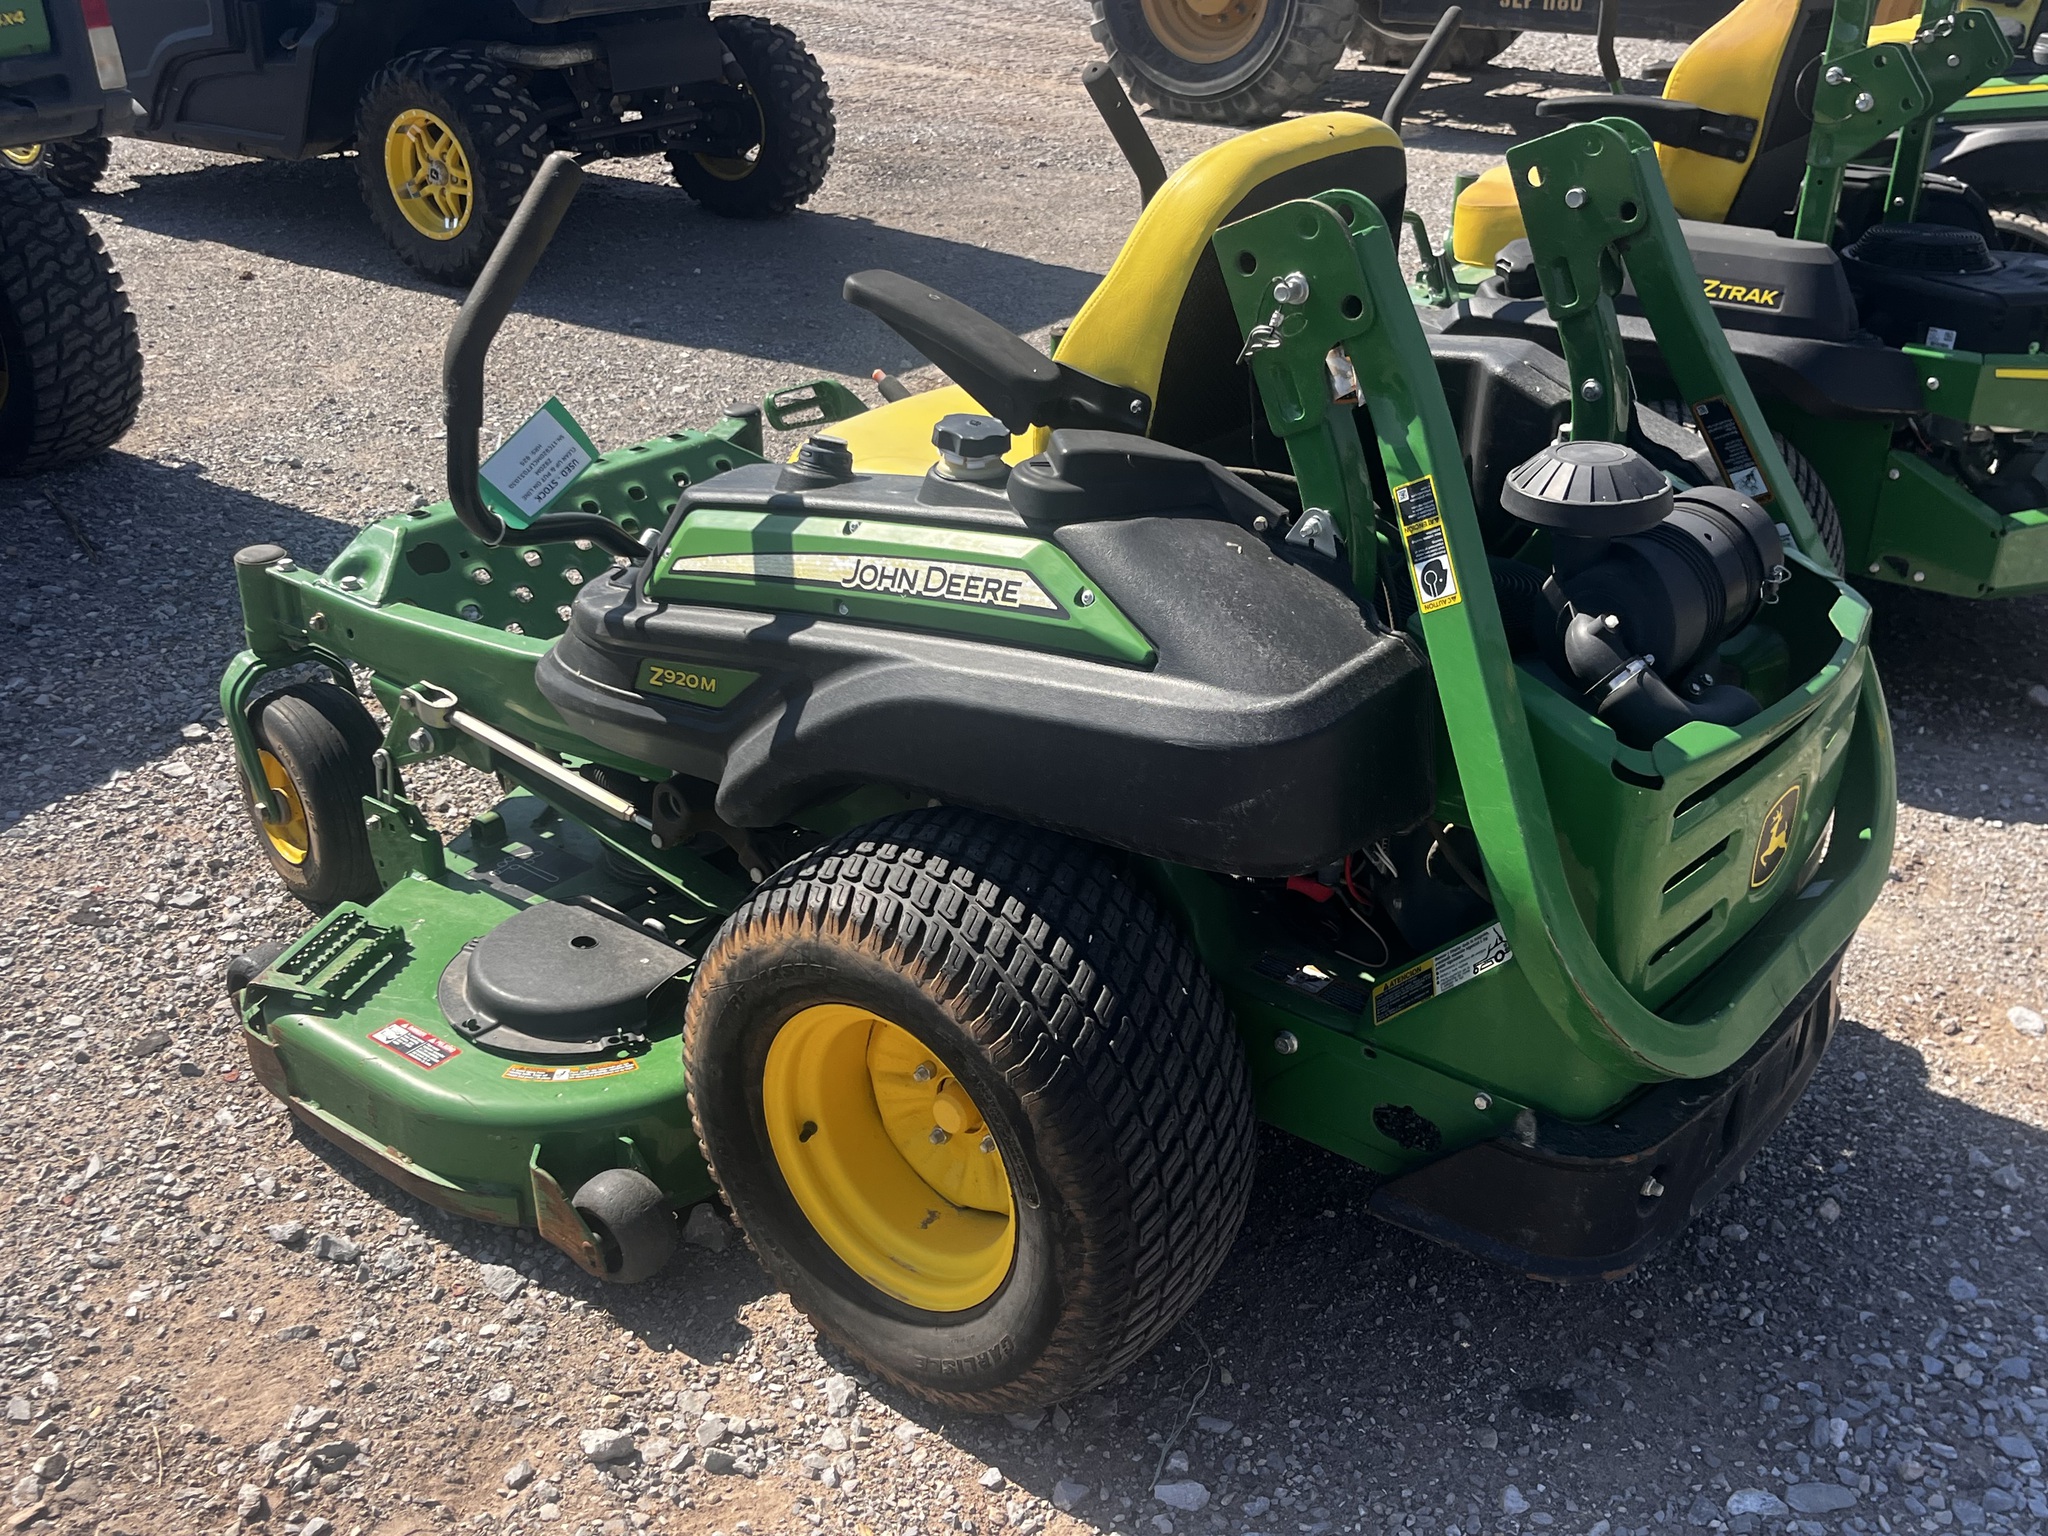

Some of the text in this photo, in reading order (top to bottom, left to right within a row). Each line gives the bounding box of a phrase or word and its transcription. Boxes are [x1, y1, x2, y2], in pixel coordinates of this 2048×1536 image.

[1703, 279, 1779, 305] ZTRAK
[561, 446, 576, 462] CLEAN
[540, 470, 552, 482] PUT
[560, 458, 579, 478] USED
[521, 488, 534, 502] LINE
[534, 478, 559, 503] STOCK
[842, 558, 1023, 606] JOHN DEERE
[1424, 598, 1452, 611] CAUTION
[649, 666, 717, 693] Z920M
[914, 1334, 1016, 1375] CARLISLE
